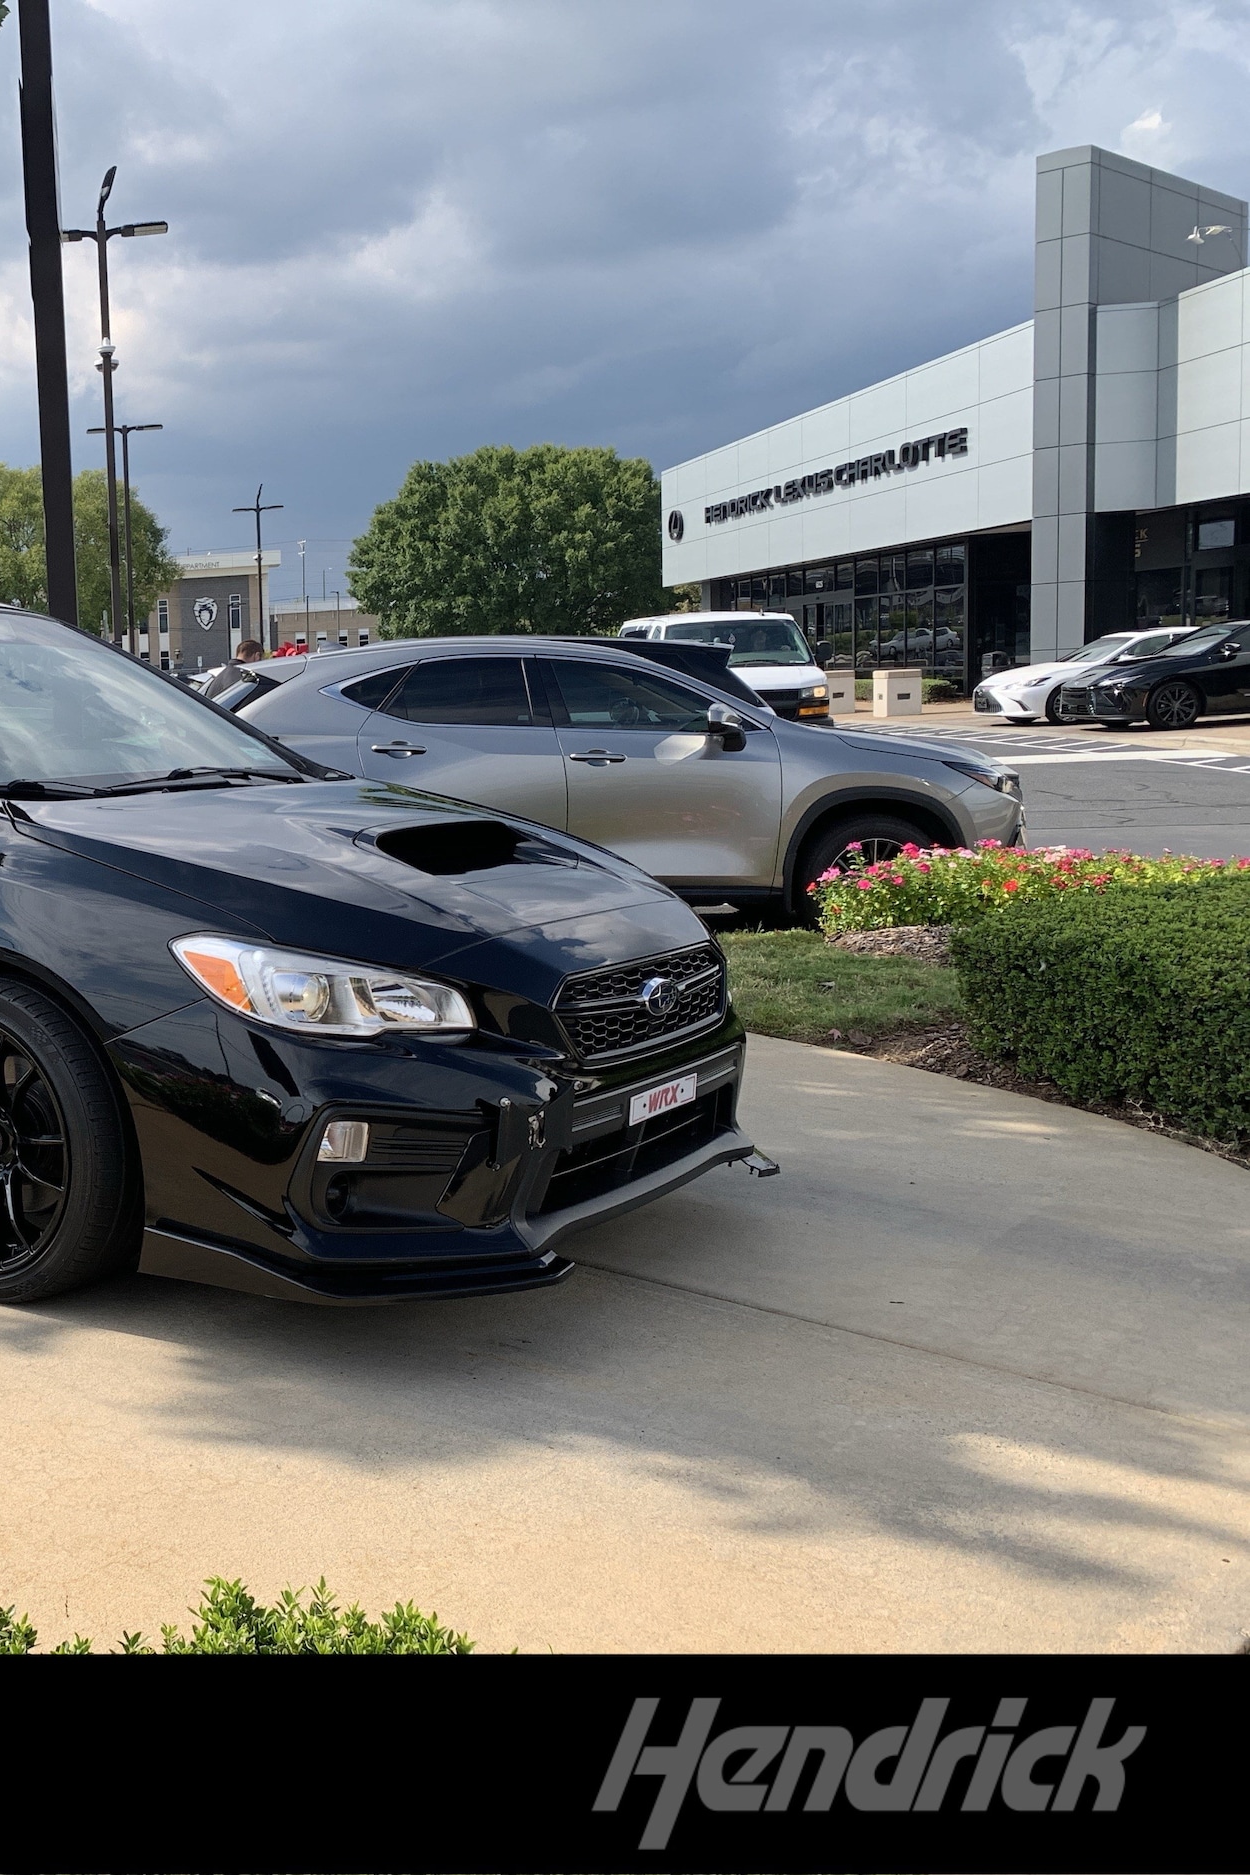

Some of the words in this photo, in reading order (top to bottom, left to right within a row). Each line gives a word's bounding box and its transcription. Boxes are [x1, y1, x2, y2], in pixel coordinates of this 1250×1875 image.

[704, 488, 774, 524] HENDRICK
[774, 469, 834, 504] LEXUS
[834, 428, 968, 486] CHARLOTTE
[648, 1083, 680, 1113] WRX
